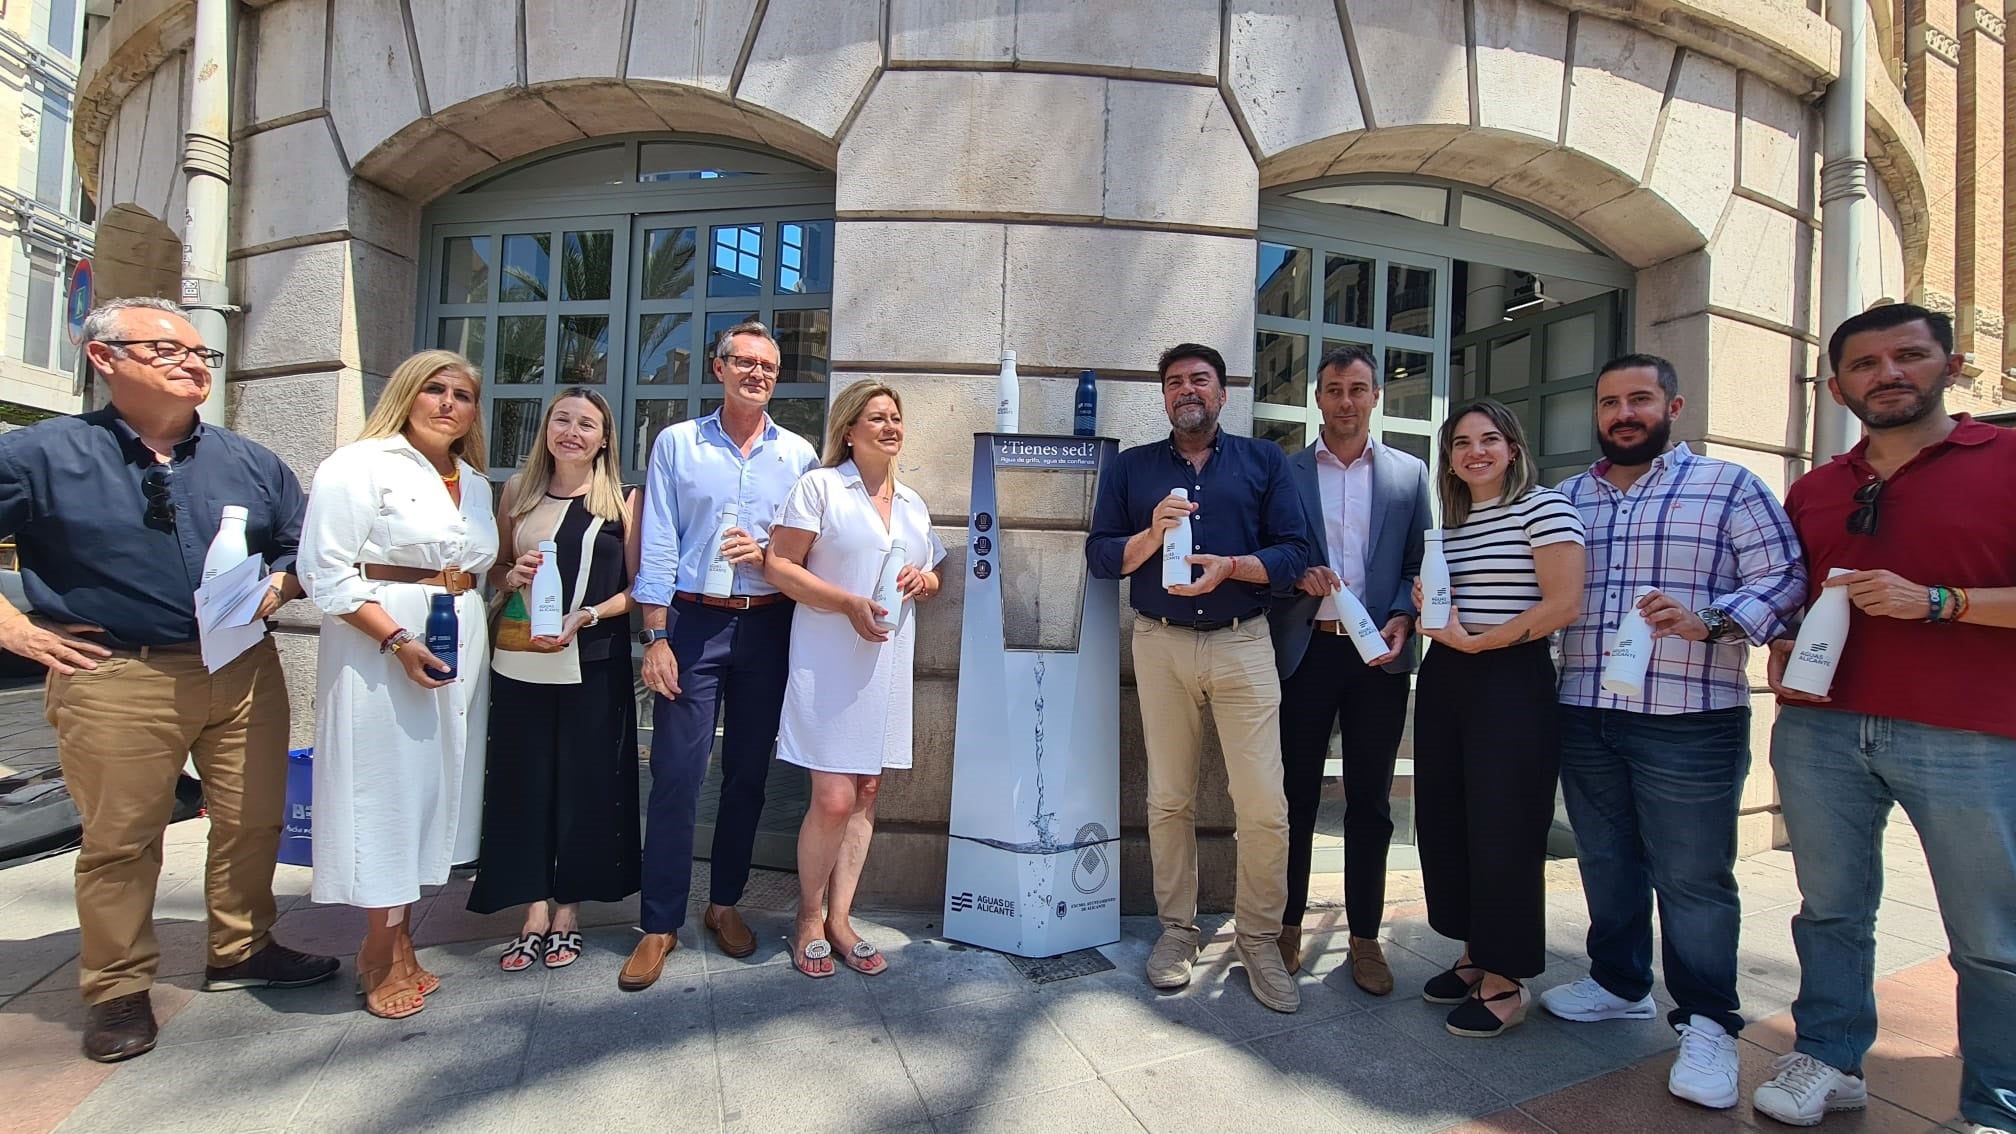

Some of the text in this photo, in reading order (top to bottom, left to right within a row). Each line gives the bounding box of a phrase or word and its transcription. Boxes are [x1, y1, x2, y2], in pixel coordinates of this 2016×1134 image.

[1001, 440, 1095, 457] ¿Tienes sed?
[973, 512, 977, 521] 1
[973, 536, 978, 545] 2
[972, 560, 978, 568] 3
[1800, 650, 1824, 660] AGUAS
[1797, 655, 1832, 667] ALICANTE
[977, 895, 1015, 909] AGUAS DE
[977, 902, 1015, 917] ALICANTE
